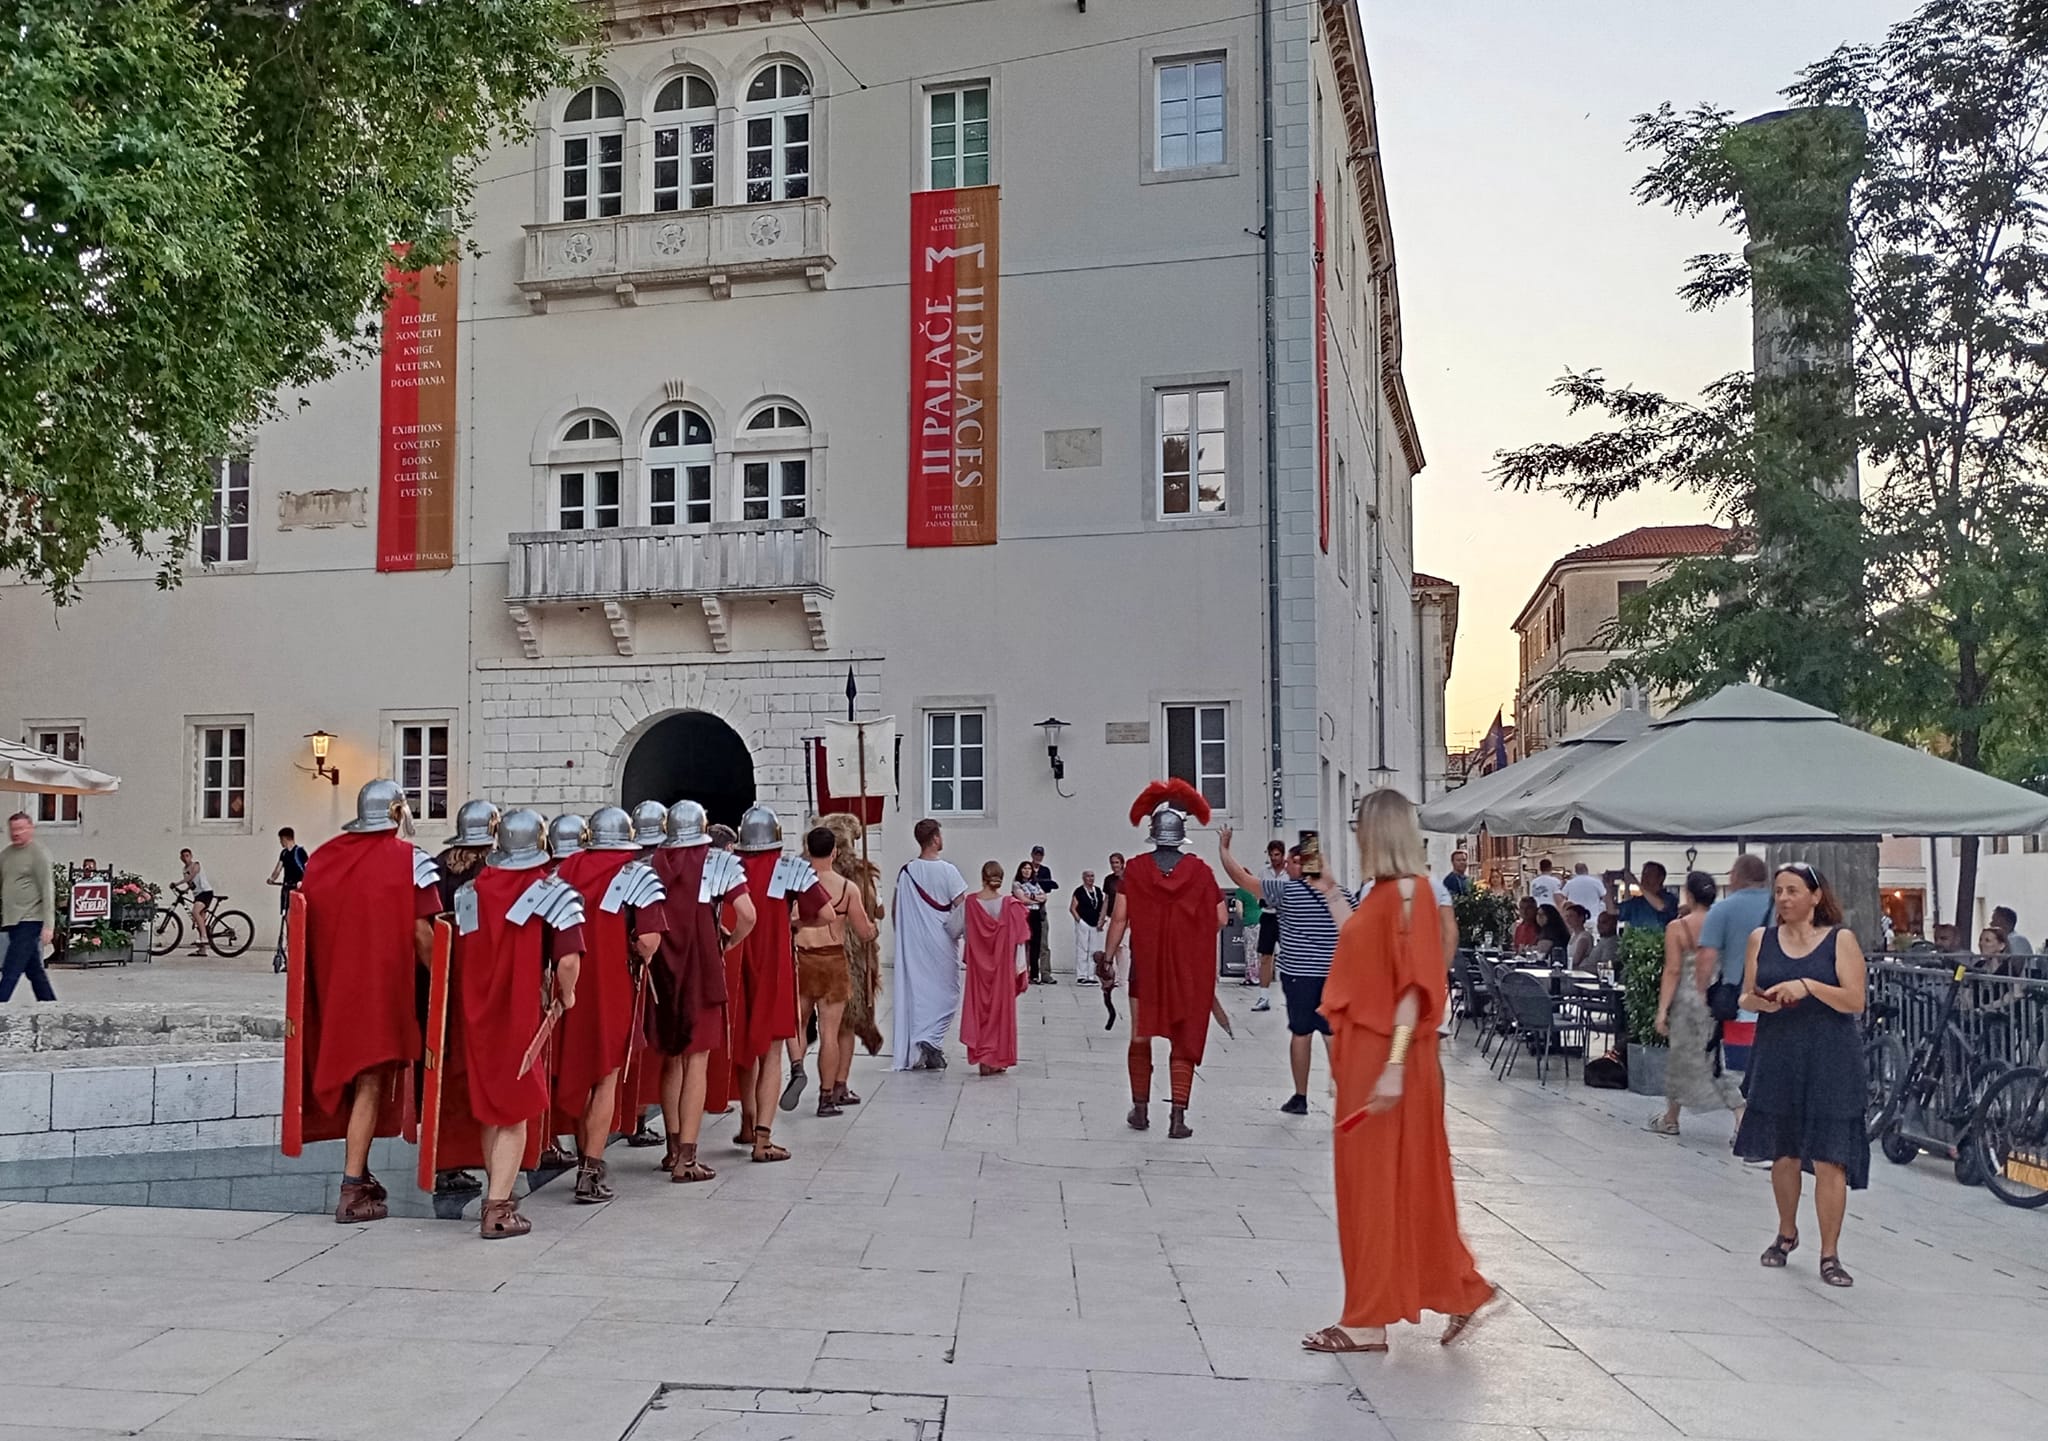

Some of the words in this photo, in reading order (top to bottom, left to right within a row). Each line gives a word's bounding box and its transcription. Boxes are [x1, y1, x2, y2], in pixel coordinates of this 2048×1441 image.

[396, 329, 441, 340] KONCERTI
[395, 361, 442, 372] KULTURNA
[918, 295, 951, 436] PALAČE
[954, 324, 984, 488] PALACES
[392, 423, 443, 435] EXIBITIONS
[393, 440, 441, 451] CONCERTS
[402, 456, 433, 466] BOOKS
[394, 471, 440, 482] CULTURAL
[400, 487, 433, 498] EVENTS
